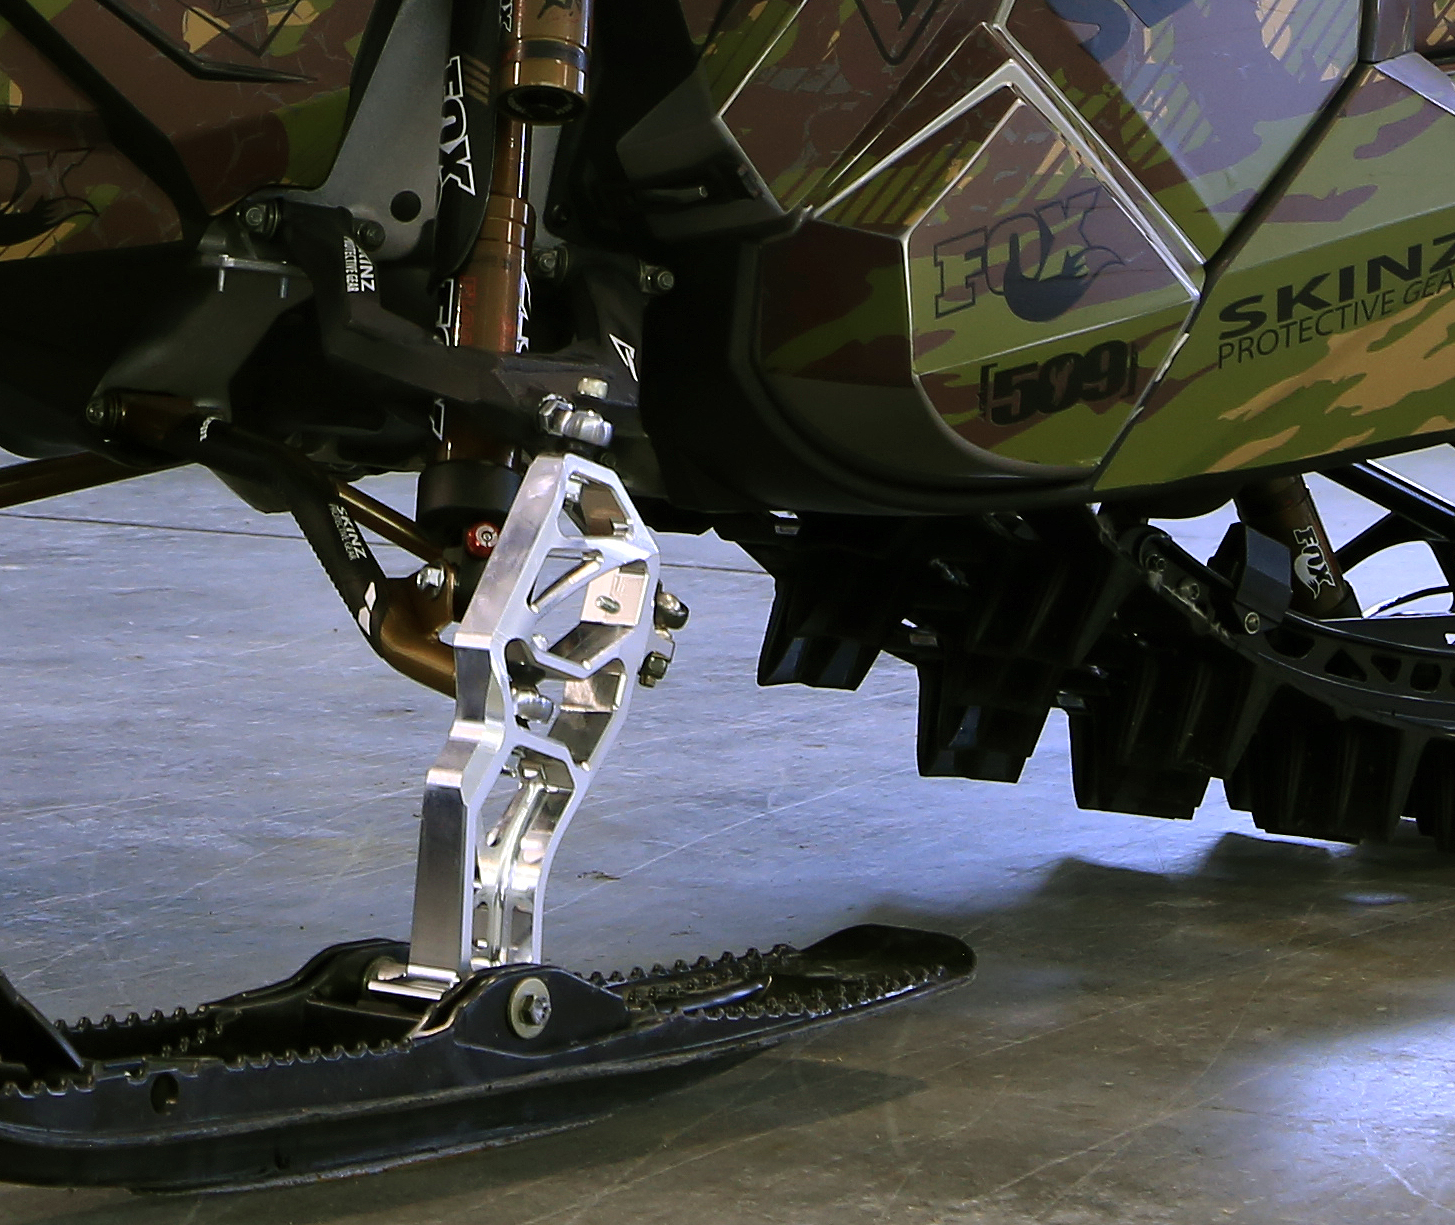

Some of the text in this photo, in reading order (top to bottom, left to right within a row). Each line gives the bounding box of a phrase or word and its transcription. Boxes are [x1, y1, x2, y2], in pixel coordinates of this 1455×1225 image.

[933, 186, 1125, 323] FOX
[1217, 292, 1396, 370] PROTECTIVE
[336, 506, 368, 559] SKINZ
[1293, 525, 1336, 600] FOX
